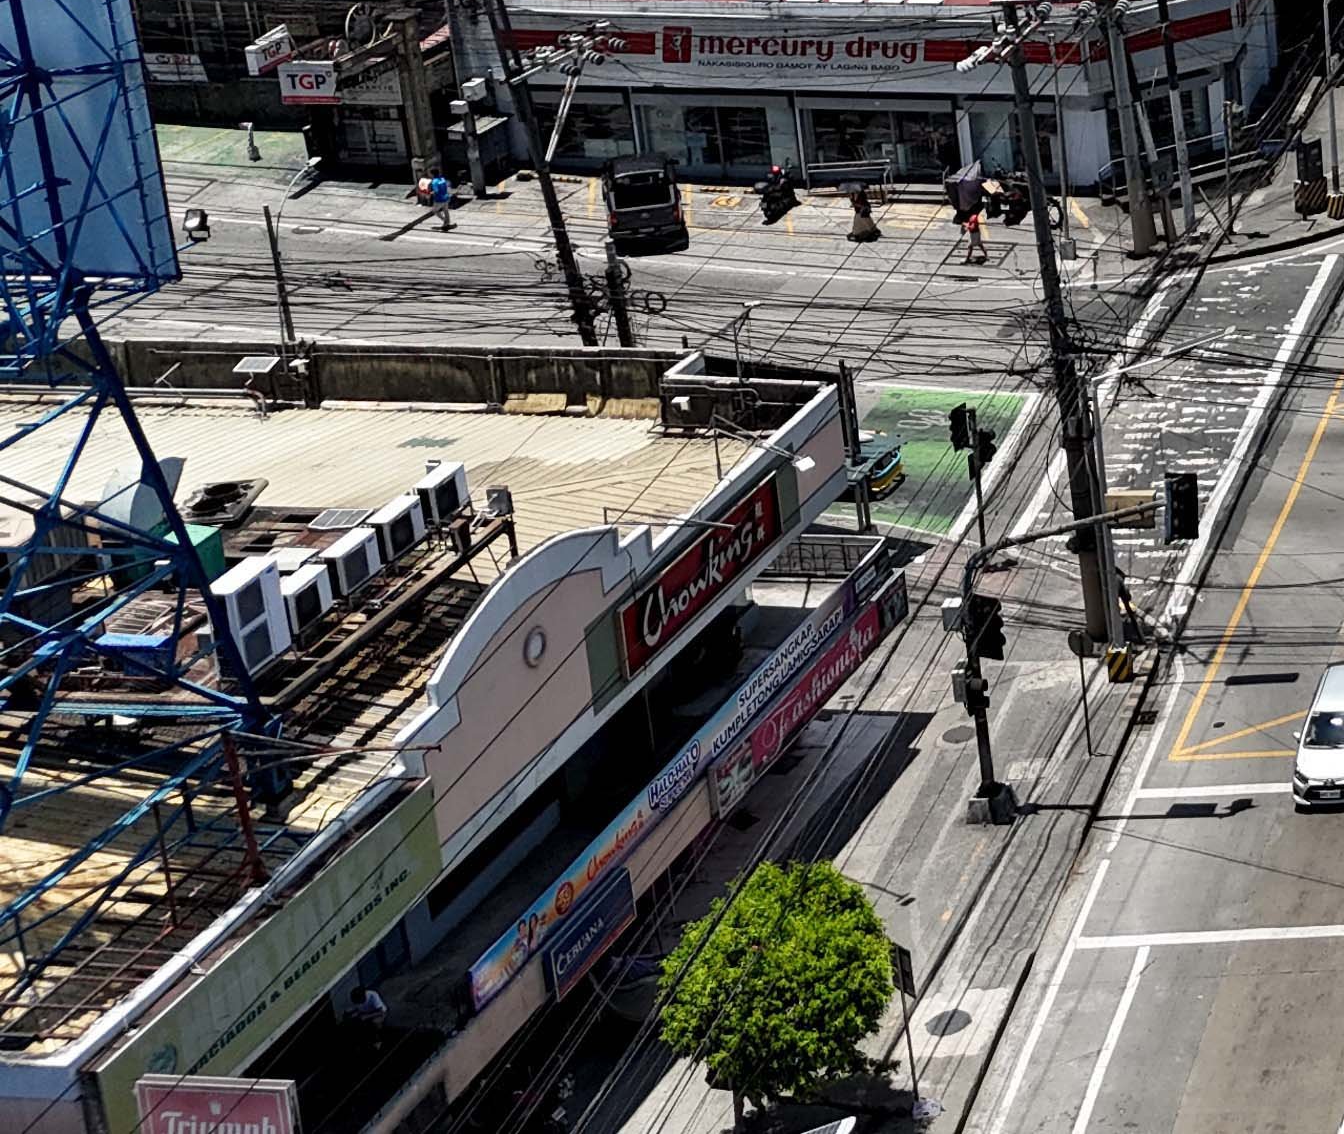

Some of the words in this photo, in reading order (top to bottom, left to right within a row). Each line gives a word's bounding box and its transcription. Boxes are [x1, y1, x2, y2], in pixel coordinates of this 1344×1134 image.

[262, 41, 282, 61] TGP
[699, 35, 834, 62] mercury
[844, 36, 918, 64] drug
[286, 73, 327, 91] TGP
[642, 522, 753, 647] Chowking
[711, 677, 782, 755] KUMPLETONG
[283, 934, 338, 992] BEAUTY
[339, 898, 384, 940] NEEDS
